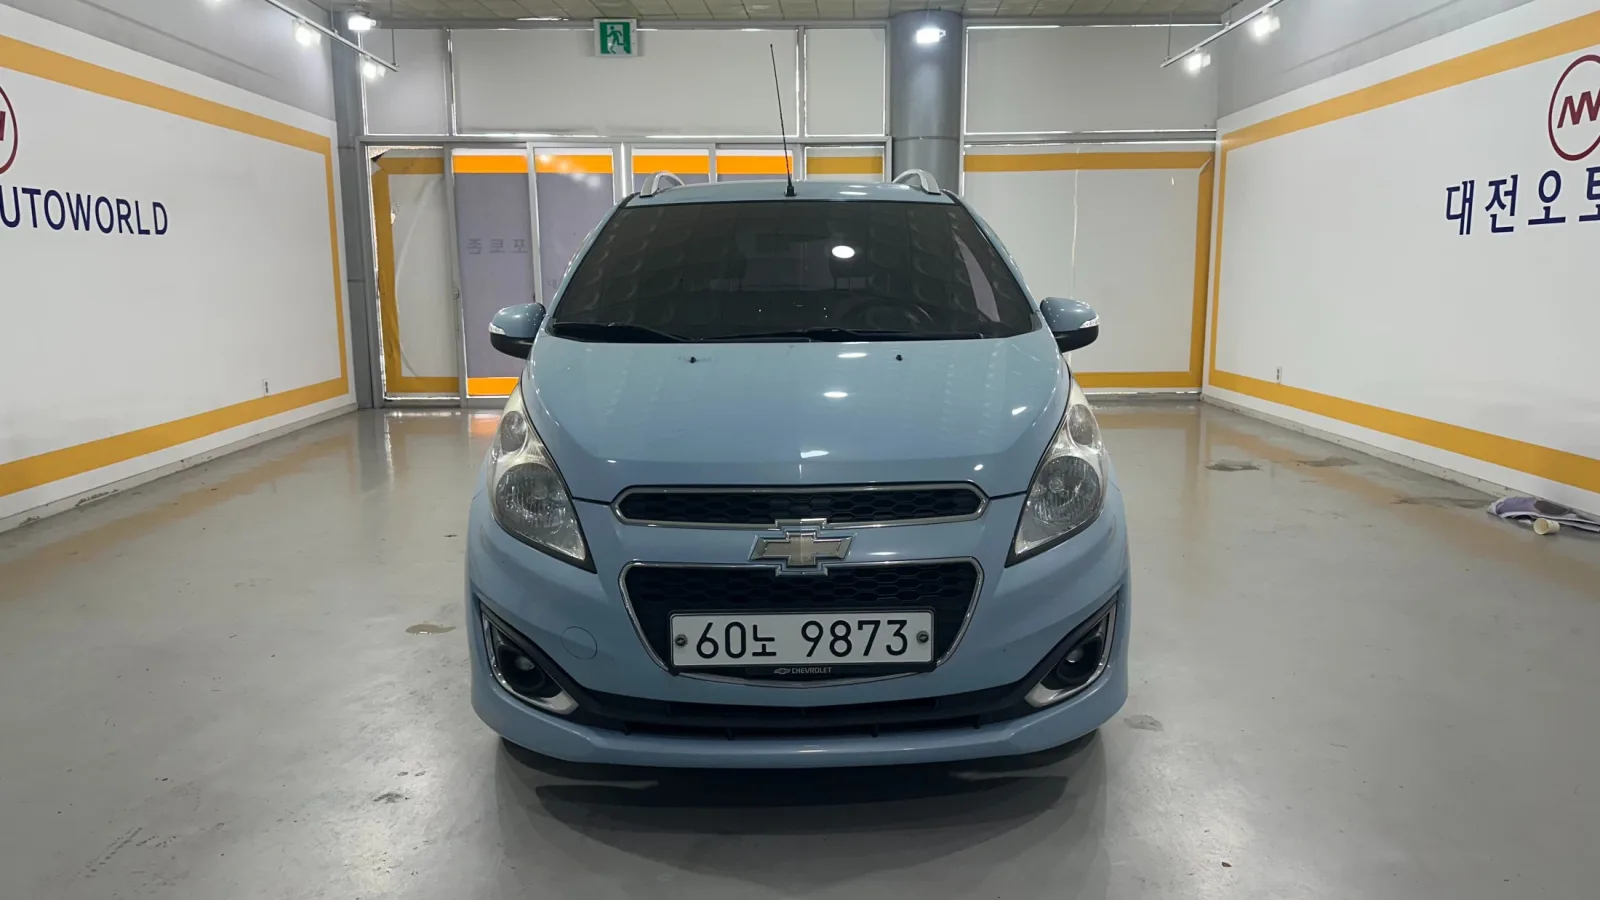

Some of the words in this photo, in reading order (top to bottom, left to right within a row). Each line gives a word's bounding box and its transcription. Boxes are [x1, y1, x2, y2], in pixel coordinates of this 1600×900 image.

[696, 621, 777, 659] 60노
[801, 620, 908, 657] 9873
[791, 666, 832, 675] CHEVROLET
